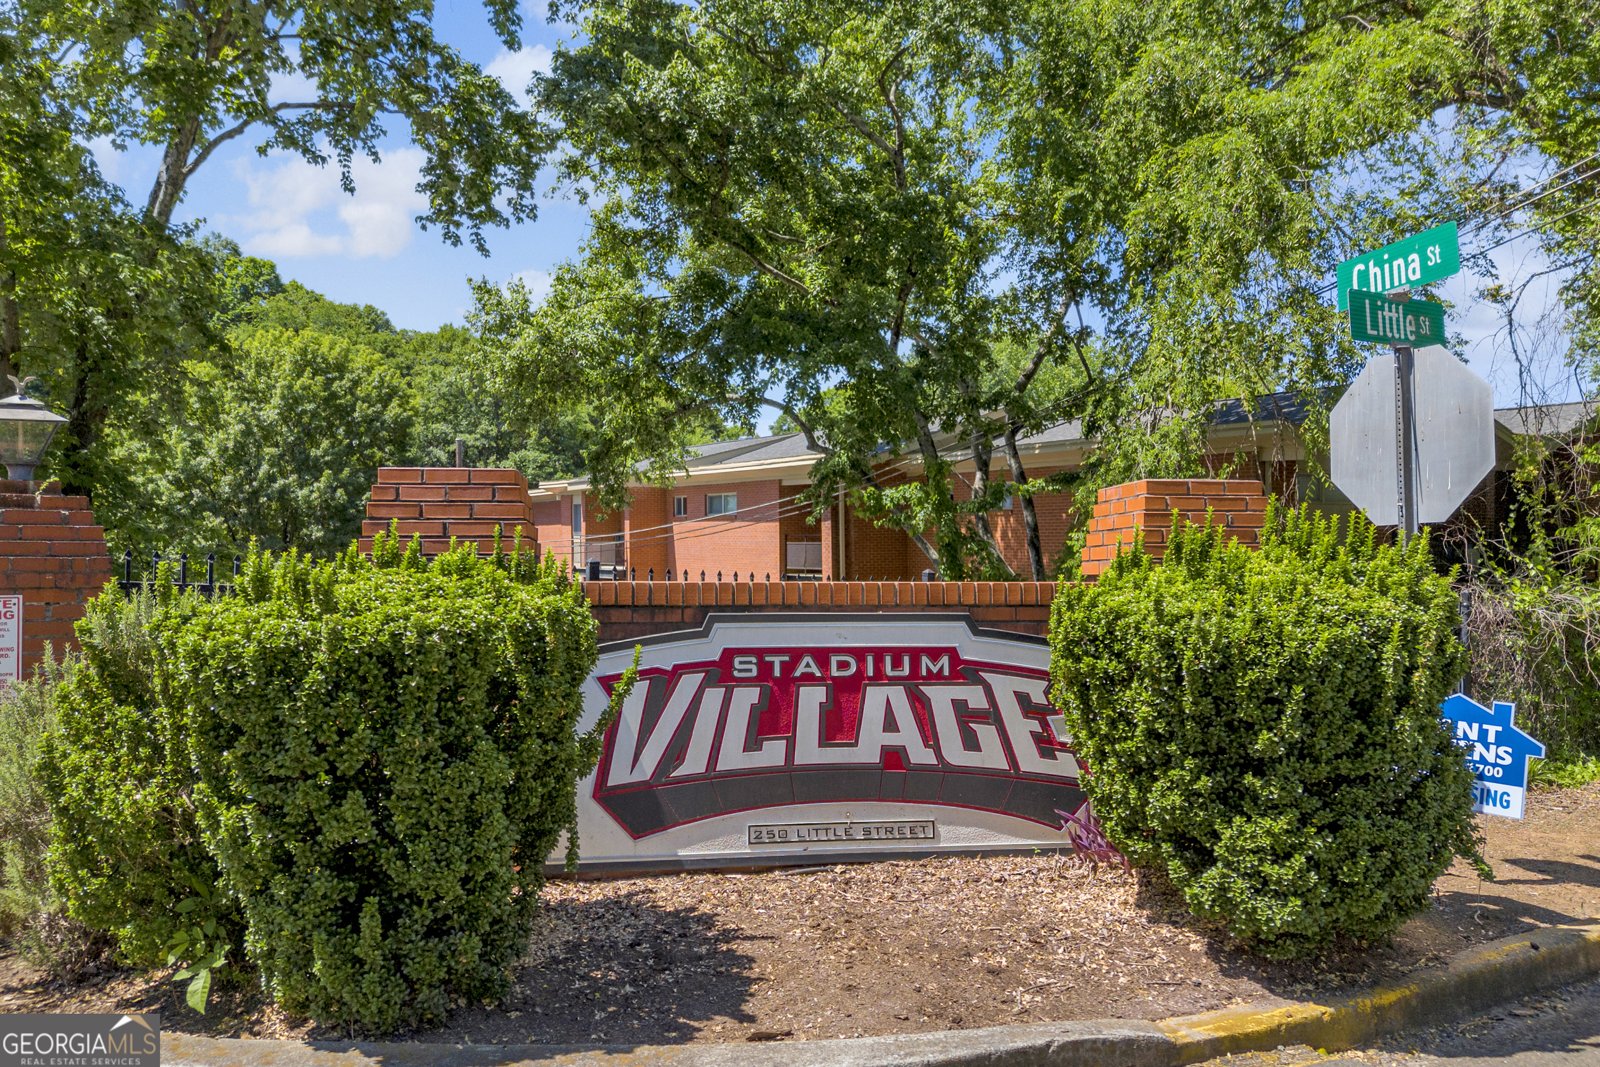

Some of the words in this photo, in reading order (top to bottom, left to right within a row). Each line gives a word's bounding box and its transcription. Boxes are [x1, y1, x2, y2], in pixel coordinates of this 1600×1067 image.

[1352, 253, 1421, 293] China
[1427, 244, 1441, 266] St
[1365, 299, 1416, 341] Little
[1419, 316, 1430, 335] St
[732, 654, 950, 678] STADIUM
[606, 671, 1080, 788] VILLAGE
[1443, 718, 1503, 744] NT
[1467, 762, 1503, 778] 700
[753, 829, 788, 840] 250
[796, 827, 854, 838] LITTLE
[862, 825, 930, 836] STREET
